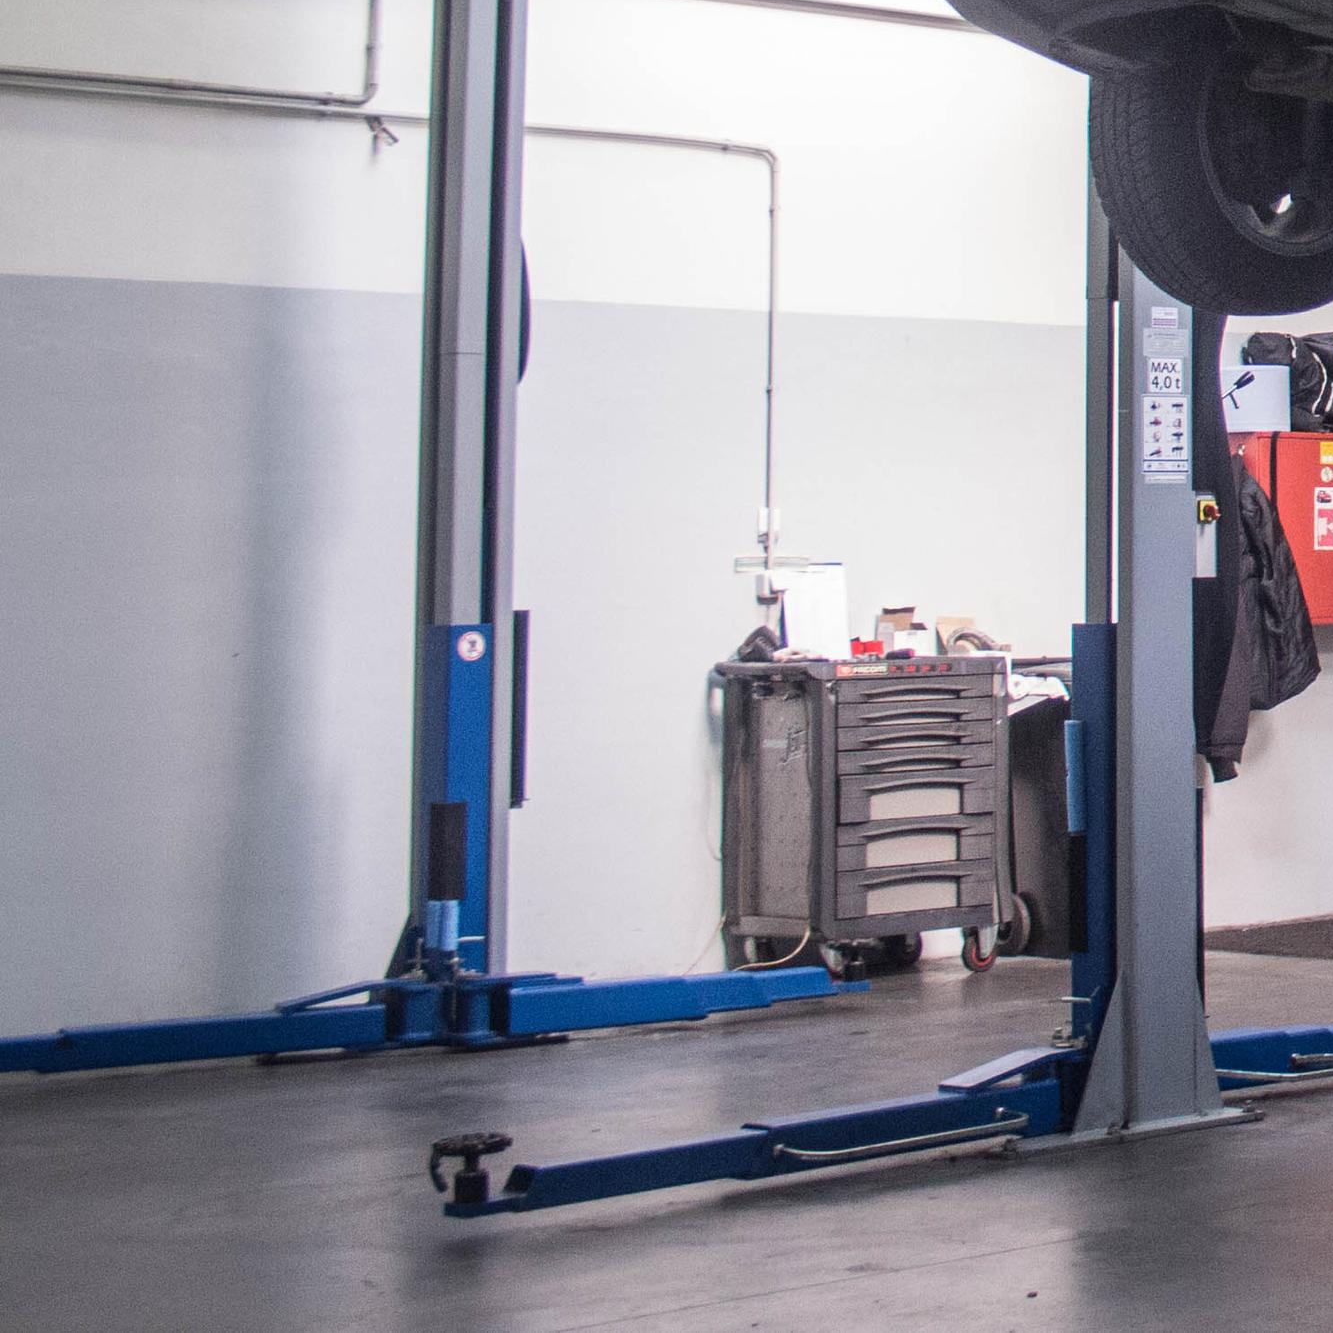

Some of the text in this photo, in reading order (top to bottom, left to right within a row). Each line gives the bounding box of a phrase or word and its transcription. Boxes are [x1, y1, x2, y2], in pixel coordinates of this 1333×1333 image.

[1150, 361, 1181, 374] MAX.
[1151, 375, 1182, 390] 4,0 t
